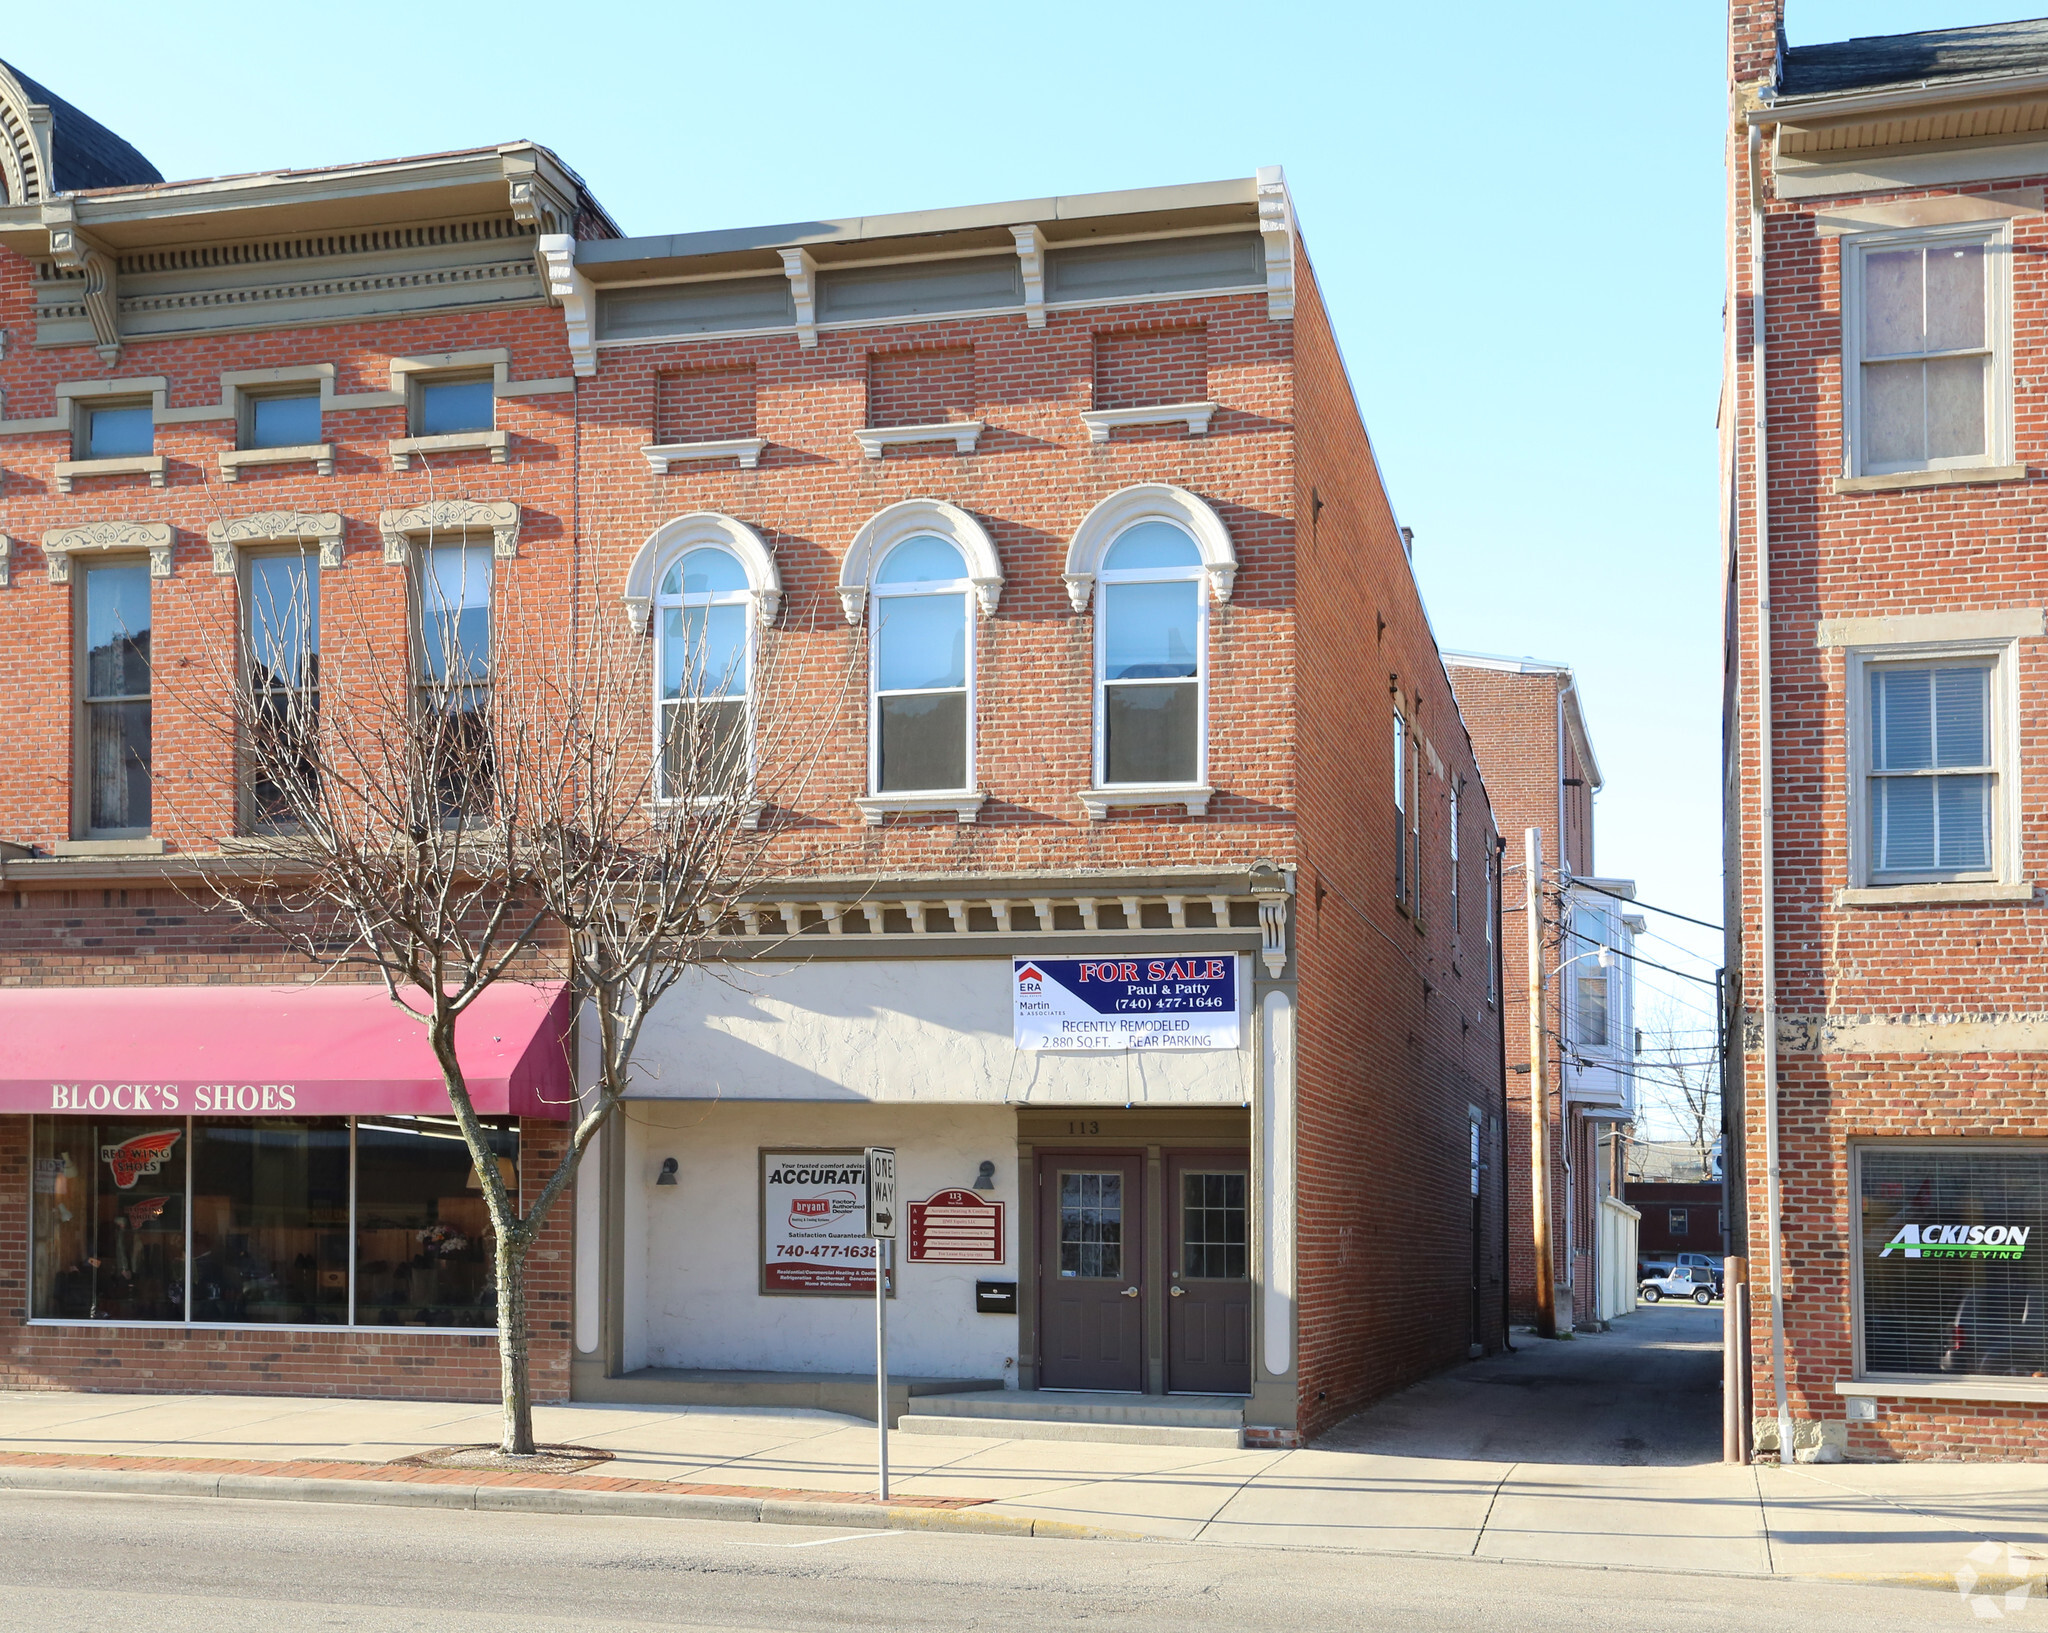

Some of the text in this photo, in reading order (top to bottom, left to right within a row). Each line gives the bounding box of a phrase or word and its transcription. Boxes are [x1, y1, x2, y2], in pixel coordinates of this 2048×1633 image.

[1079, 960, 1225, 982] FOR SALE
[1020, 983, 1041, 991] ERA
[1128, 984, 1210, 996] Paul & Patty
[1020, 1001, 1050, 1010] Martin
[1116, 997, 1223, 1011] (740) 477-1646
[1062, 1019, 1190, 1032] RECENTLY REMODELED
[1077, 1035, 1111, 1048] SQ.FT.
[1129, 1035, 1159, 1047] REAR
[1163, 1034, 1212, 1047] PARKING
[50, 1084, 296, 1110] BLOCK'S SHOES
[1069, 1121, 1099, 1134] 113
[103, 1148, 170, 1159] RED WING
[117, 1161, 157, 1172] SHOES
[875, 1157, 893, 1178] ONE
[875, 1182, 894, 1202] WAY
[949, 1193, 962, 1201] 113
[796, 1202, 825, 1213] bryant
[1879, 1224, 2030, 1258] ACKISON
[776, 1245, 877, 1257] 740-477-1638
[1922, 1251, 2023, 1260] SURVEYING
